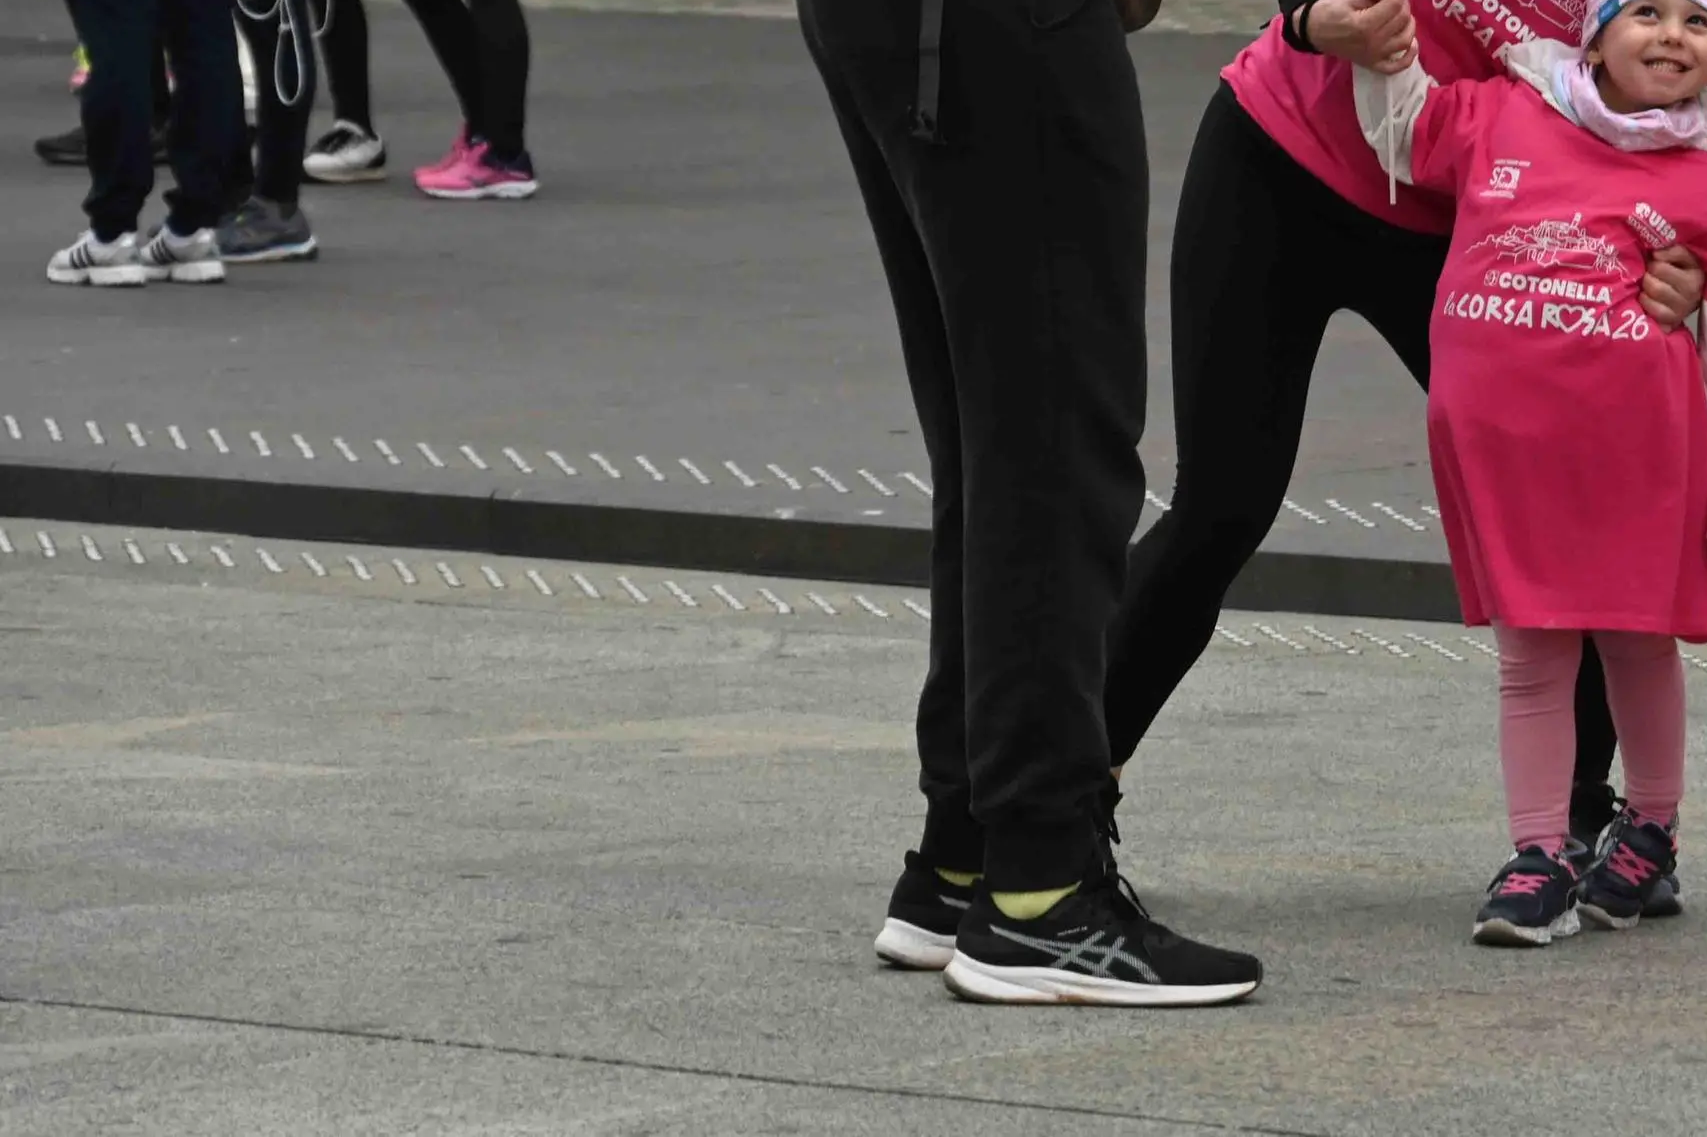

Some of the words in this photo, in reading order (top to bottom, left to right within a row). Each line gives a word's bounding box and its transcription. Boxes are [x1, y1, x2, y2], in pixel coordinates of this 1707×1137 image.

[1498, 271, 1612, 304] COTONELLA
[1456, 293, 1533, 328] CORSA
[1611, 309, 1650, 341] 26
